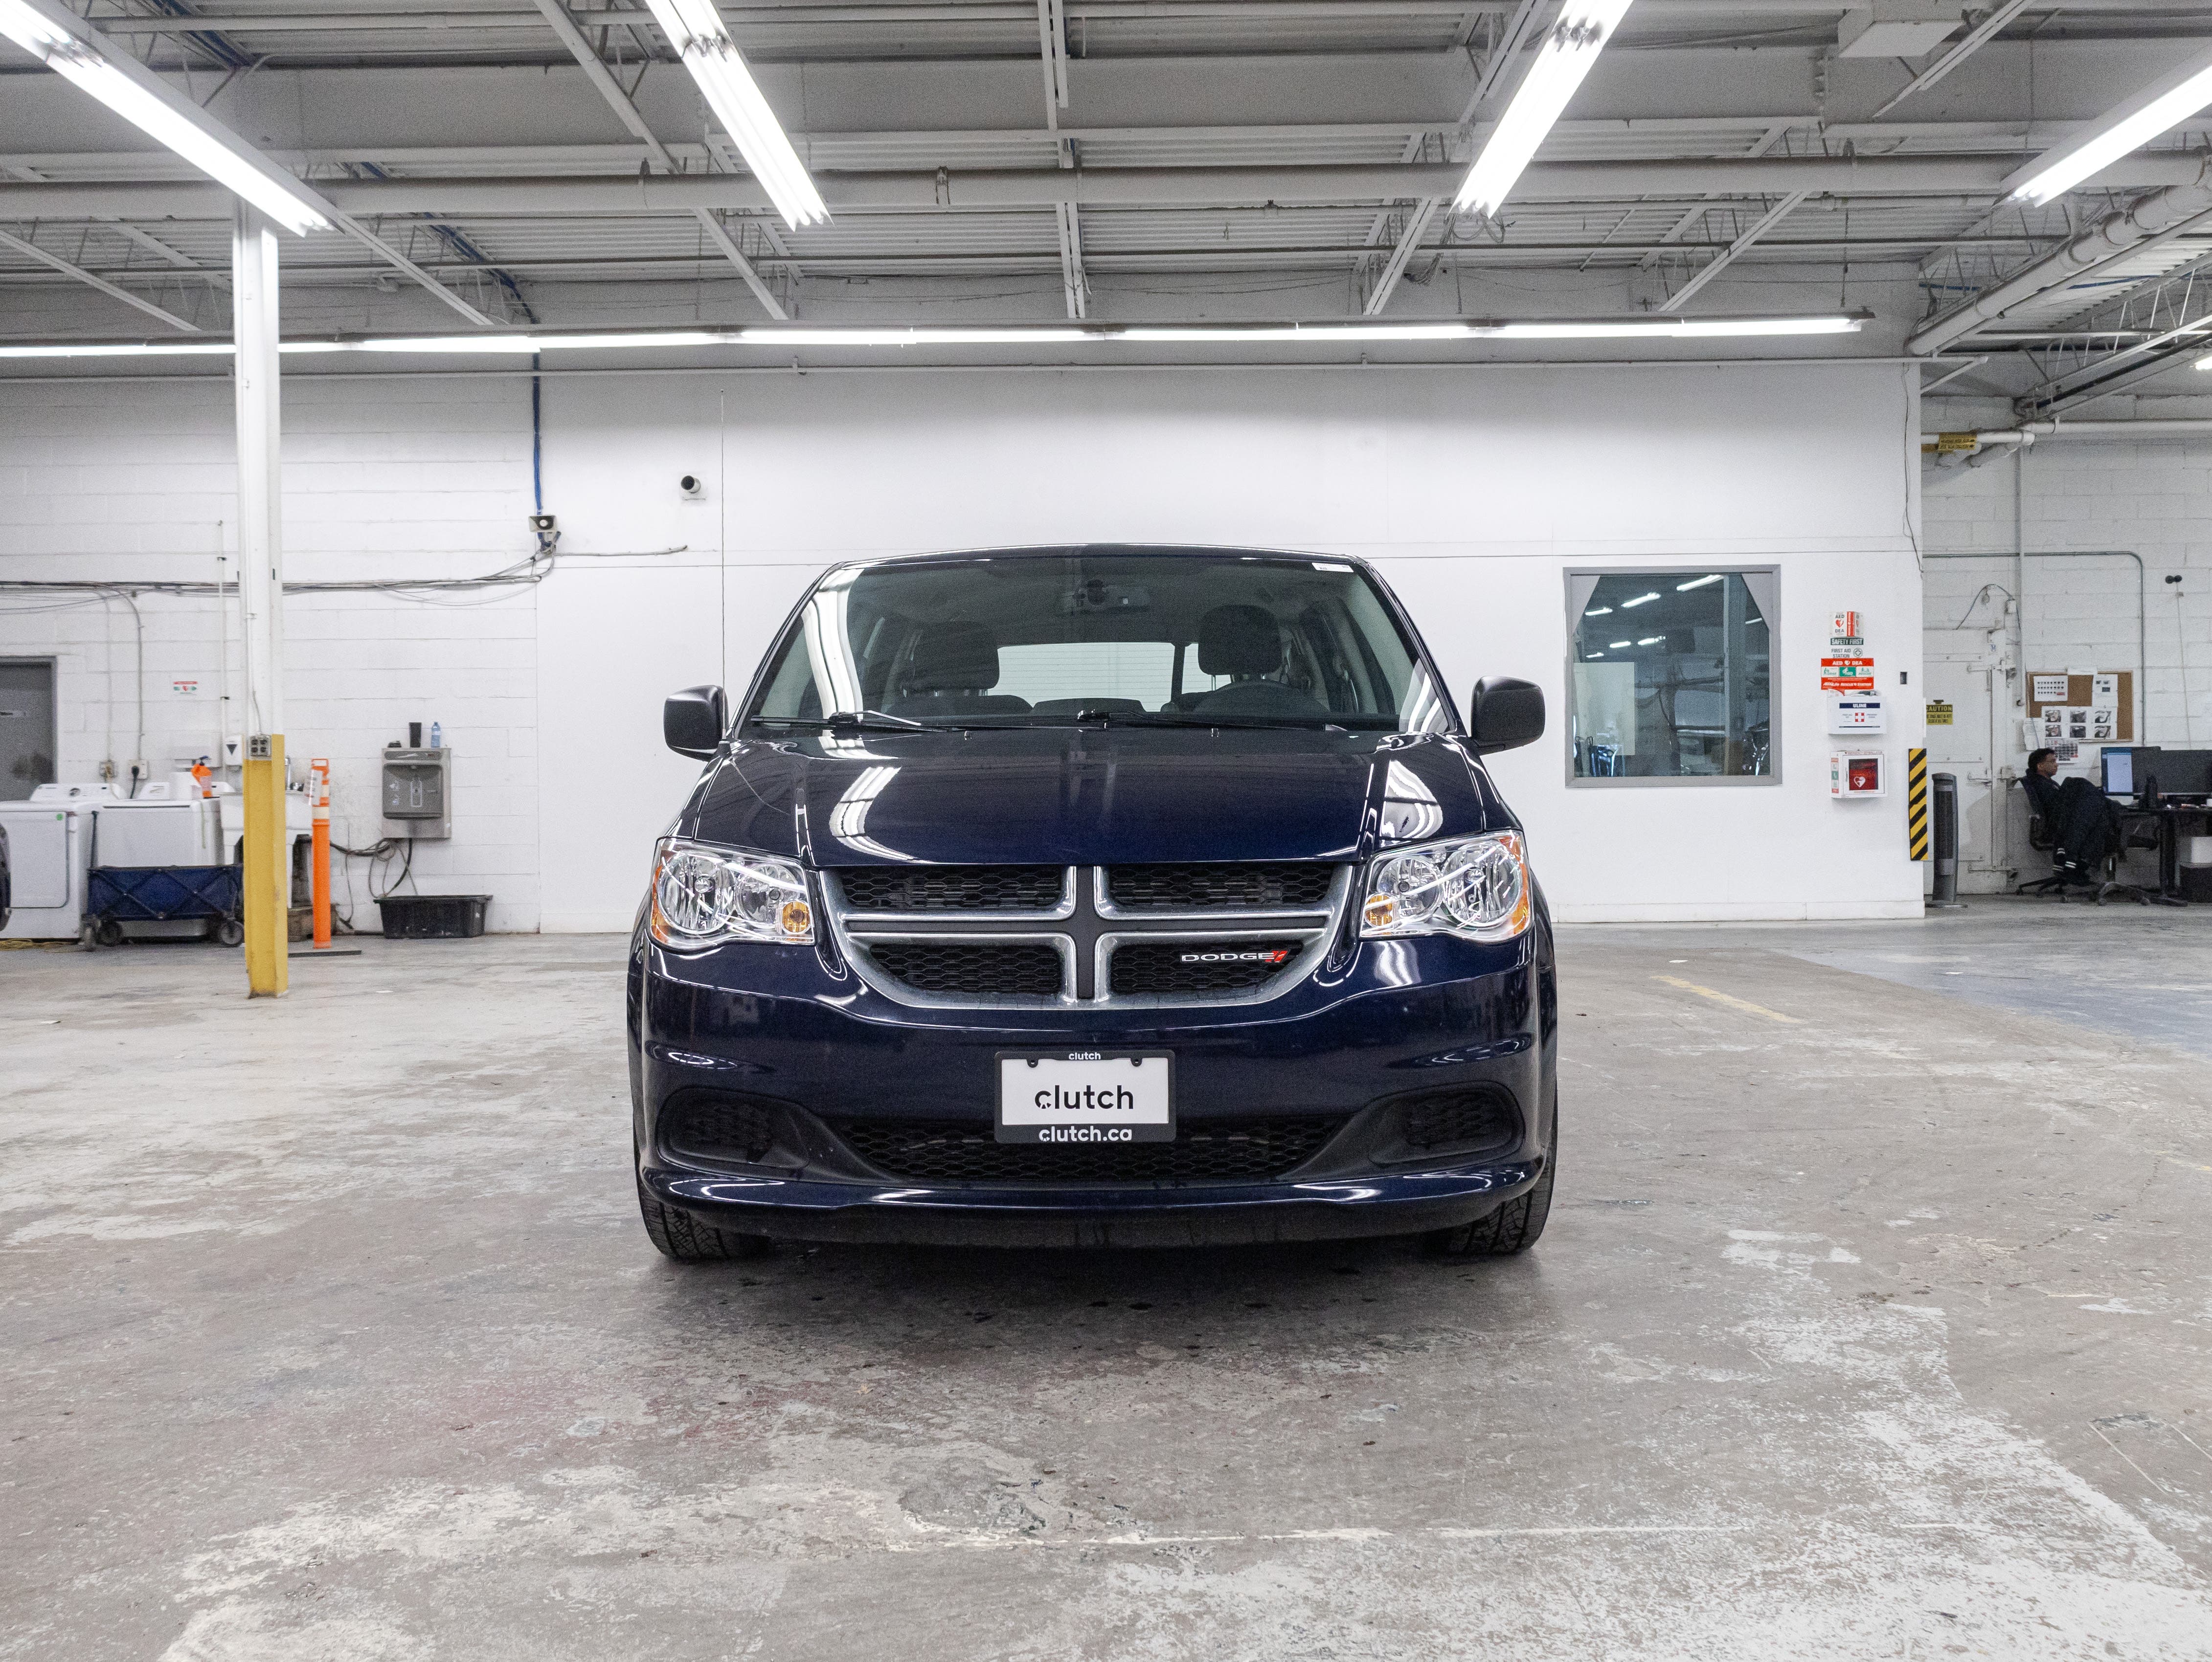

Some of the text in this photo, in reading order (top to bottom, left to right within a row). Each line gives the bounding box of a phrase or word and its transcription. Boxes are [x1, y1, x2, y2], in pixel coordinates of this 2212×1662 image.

[1181, 952, 1275, 962] DODGE
[1068, 1052, 1101, 1060] clutch
[1035, 1085, 1133, 1109] clutch
[1038, 1125, 1132, 1142] clutch.ca
